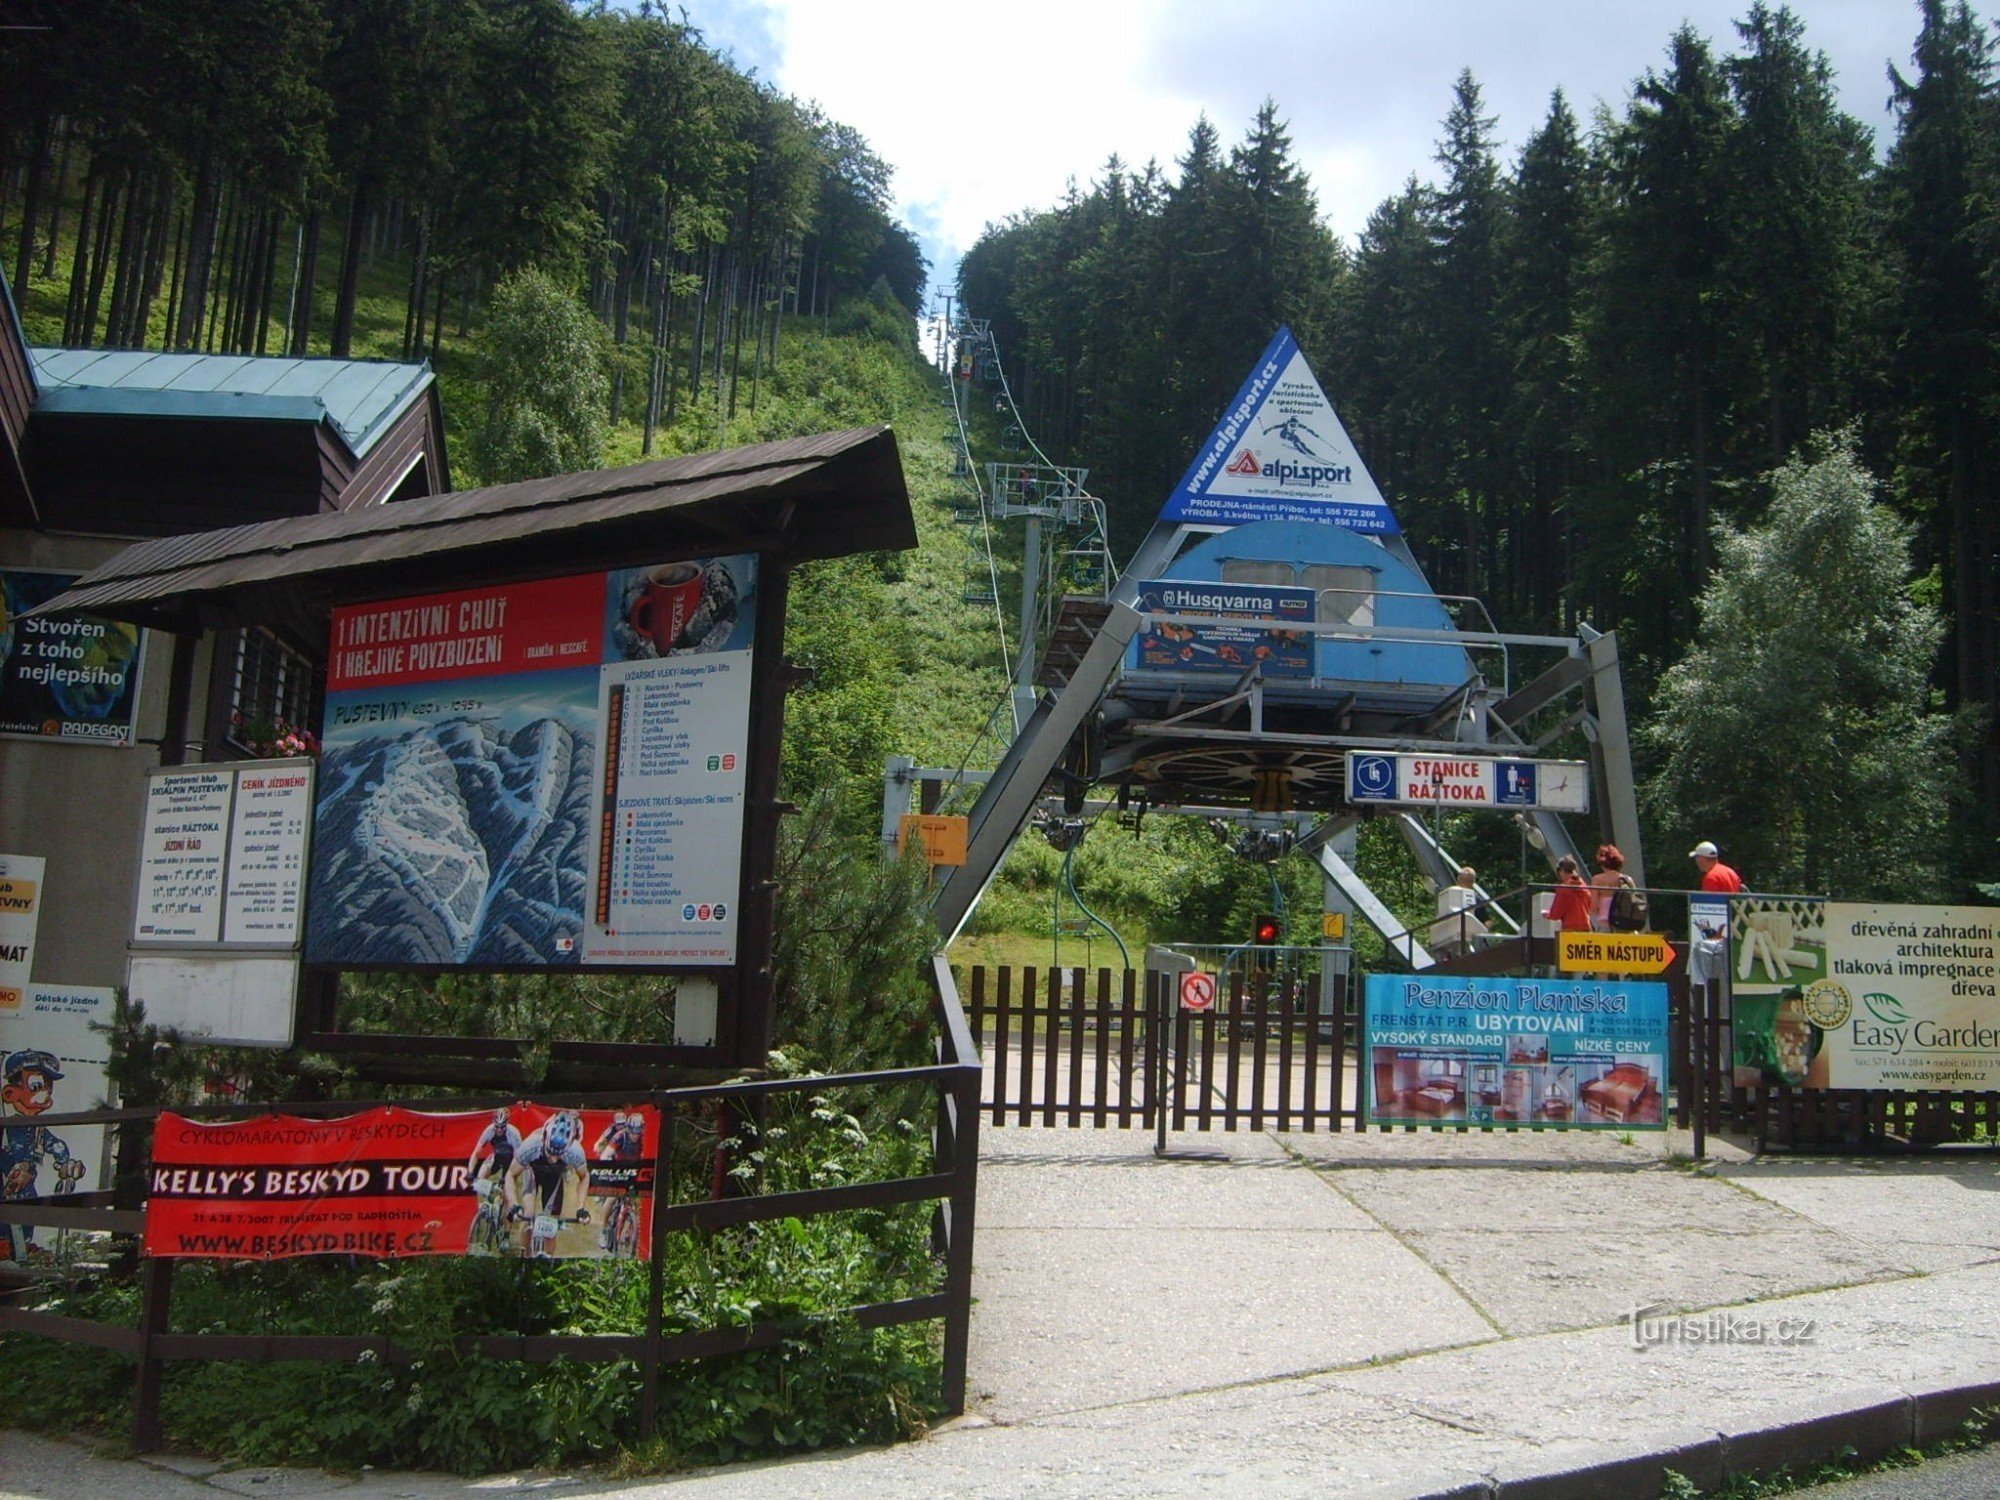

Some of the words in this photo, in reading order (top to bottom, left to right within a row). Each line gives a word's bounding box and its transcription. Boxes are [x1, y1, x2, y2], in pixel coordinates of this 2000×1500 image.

[1187, 361, 1278, 494] www.alpisport.cz
[1262, 458, 1351, 488] alpisport
[1343, 509, 1359, 517] 722
[1352, 519, 1368, 527] 722
[1177, 591, 1272, 611] Husqvarna
[26, 617, 105, 638] Stvořen
[21, 643, 33, 656] z
[39, 640, 84, 659] toho
[19, 663, 123, 686] nejlepšího
[335, 699, 410, 725] PUSTEVNY
[1414, 760, 1480, 778] STANICE
[1408, 779, 1486, 801] RÁZTOKA
[1851, 921, 1917, 938] dřevěná
[1922, 923, 1993, 940] zahradní
[1567, 940, 1602, 960] SMĚR
[1607, 941, 1664, 962] NÁSTUPU
[1896, 942, 1994, 958] architektura
[1834, 959, 1893, 975] tlaková
[1899, 961, 1995, 980] impregnace
[1404, 983, 1510, 1011] Penzion
[1516, 984, 1627, 1013] Planiska
[1951, 980, 1996, 996] dřeva
[1371, 1012, 1443, 1028] FRENŠTÁT
[1474, 1012, 1584, 1033] UBYTOVÁNÍ
[1371, 1030, 1428, 1045] VYSOKÝ
[1430, 1033, 1503, 1046] STANDARD
[1616, 1040, 1651, 1053] CENY
[1853, 1019, 1908, 1055] Easy
[1881, 1069, 1986, 1085] www.easygarden.cz
[179, 1128, 330, 1146] CYKLOMARATONY
[335, 1129, 344, 1141] V
[350, 1124, 445, 1142] BESKYDECH
[153, 1170, 256, 1194] KELLY'S
[265, 1167, 370, 1195] BESKYD
[384, 1166, 469, 1191] TOUR
[248, 1215, 273, 1224] 2007
[332, 1212, 352, 1222] POD
[178, 1230, 435, 1253] WWW.BESKYDBIKE.CZ
